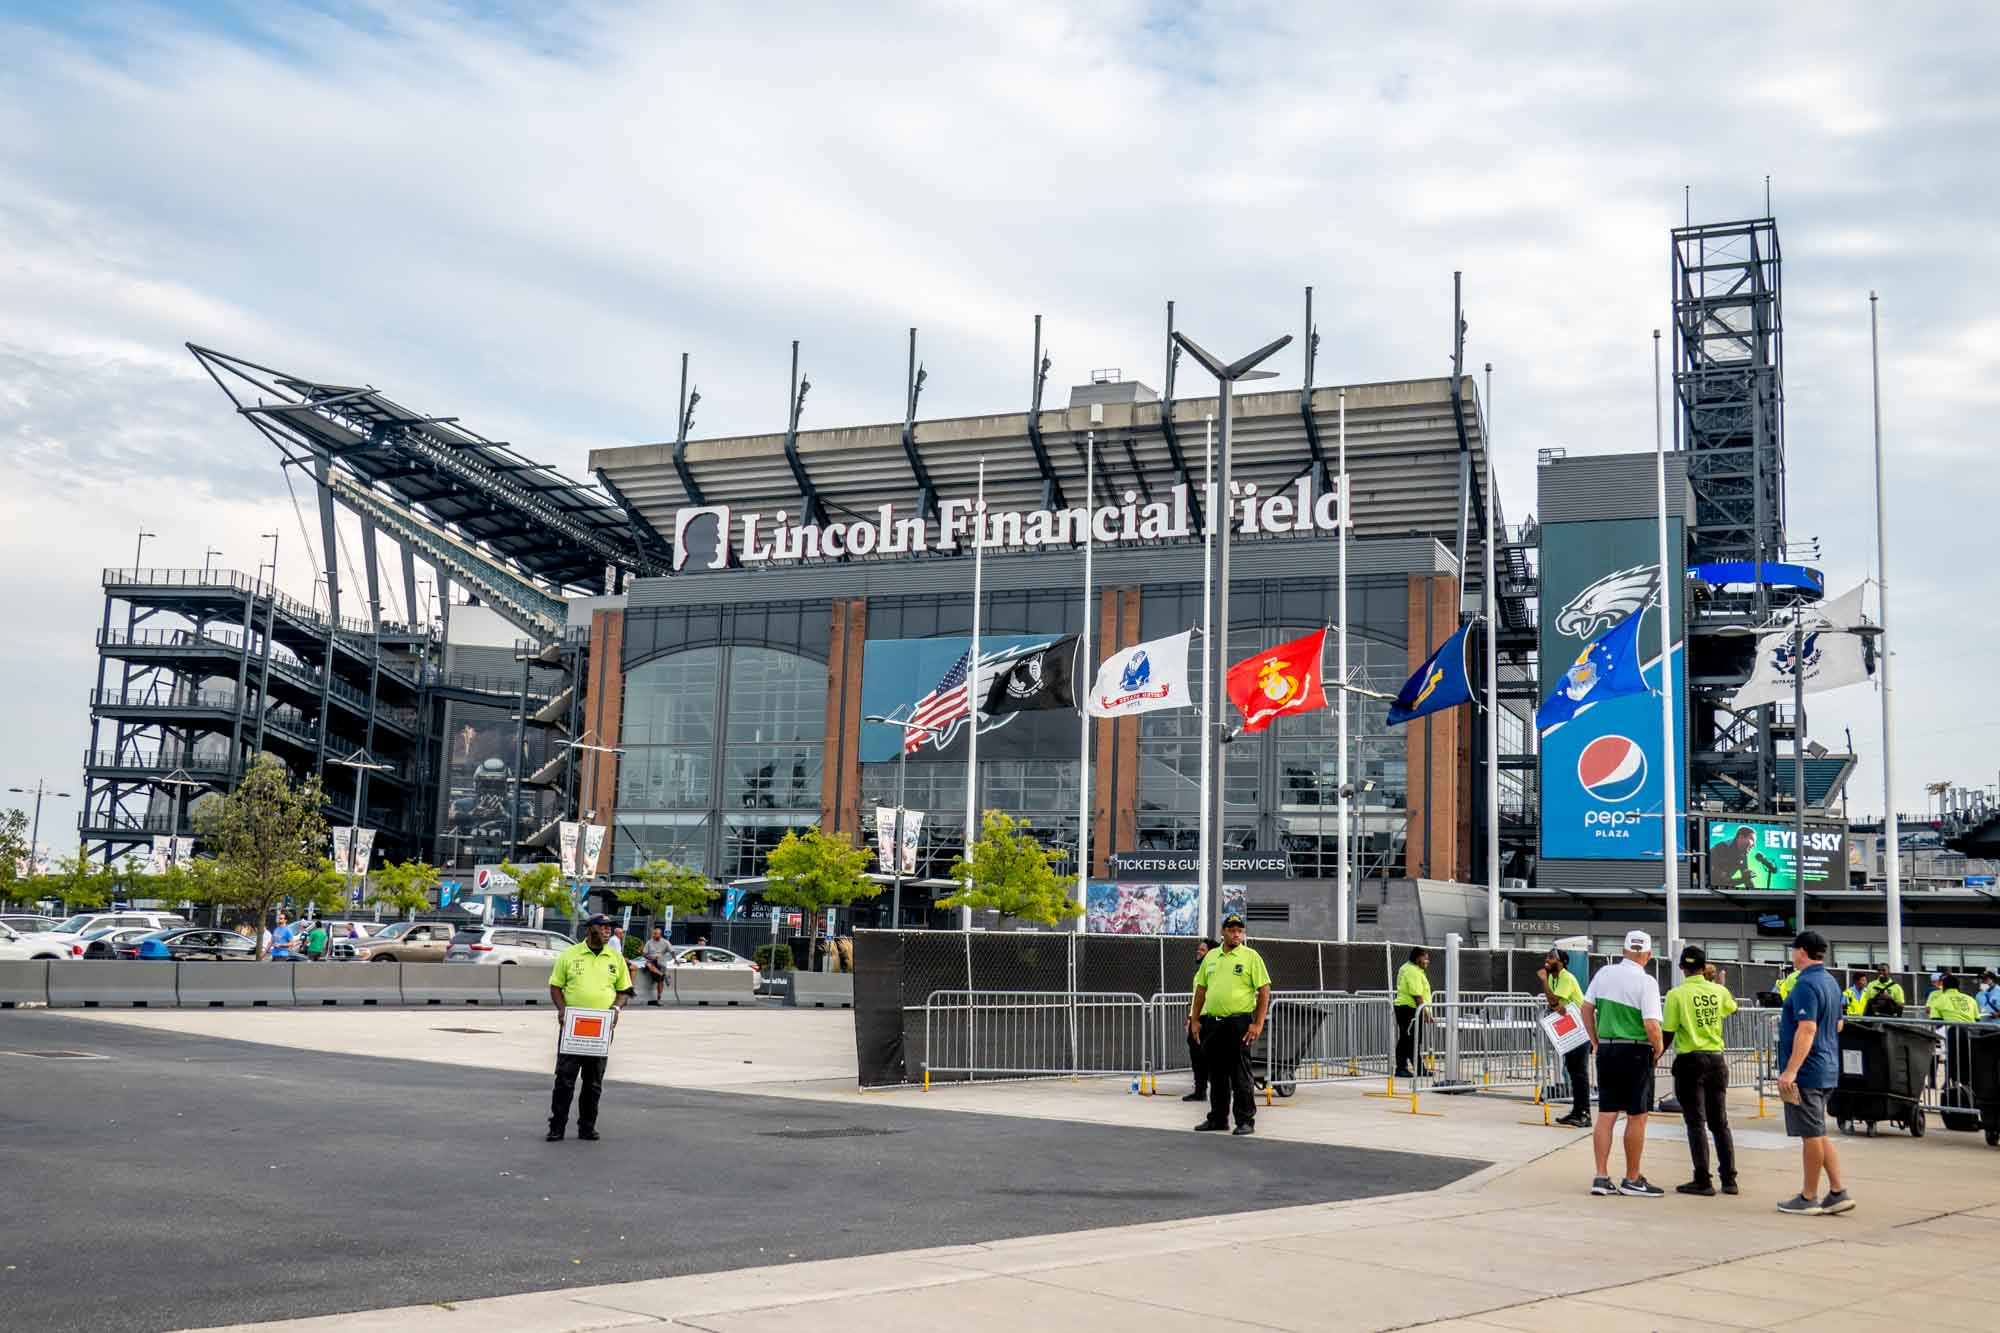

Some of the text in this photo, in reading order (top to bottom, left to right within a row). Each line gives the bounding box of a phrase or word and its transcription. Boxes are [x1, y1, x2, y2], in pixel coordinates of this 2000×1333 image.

[739, 503, 928, 562] Lincoln
[936, 482, 1190, 550] Financial
[1584, 807, 1641, 828] pepsi
[1595, 829, 1630, 838] PLAZA
[1811, 832, 1842, 851] SKY
[1117, 858, 1286, 871] TICKETS & GUE SERVICES
[1512, 921, 1560, 931] TICKETS
[1693, 994, 1718, 1007] CSC
